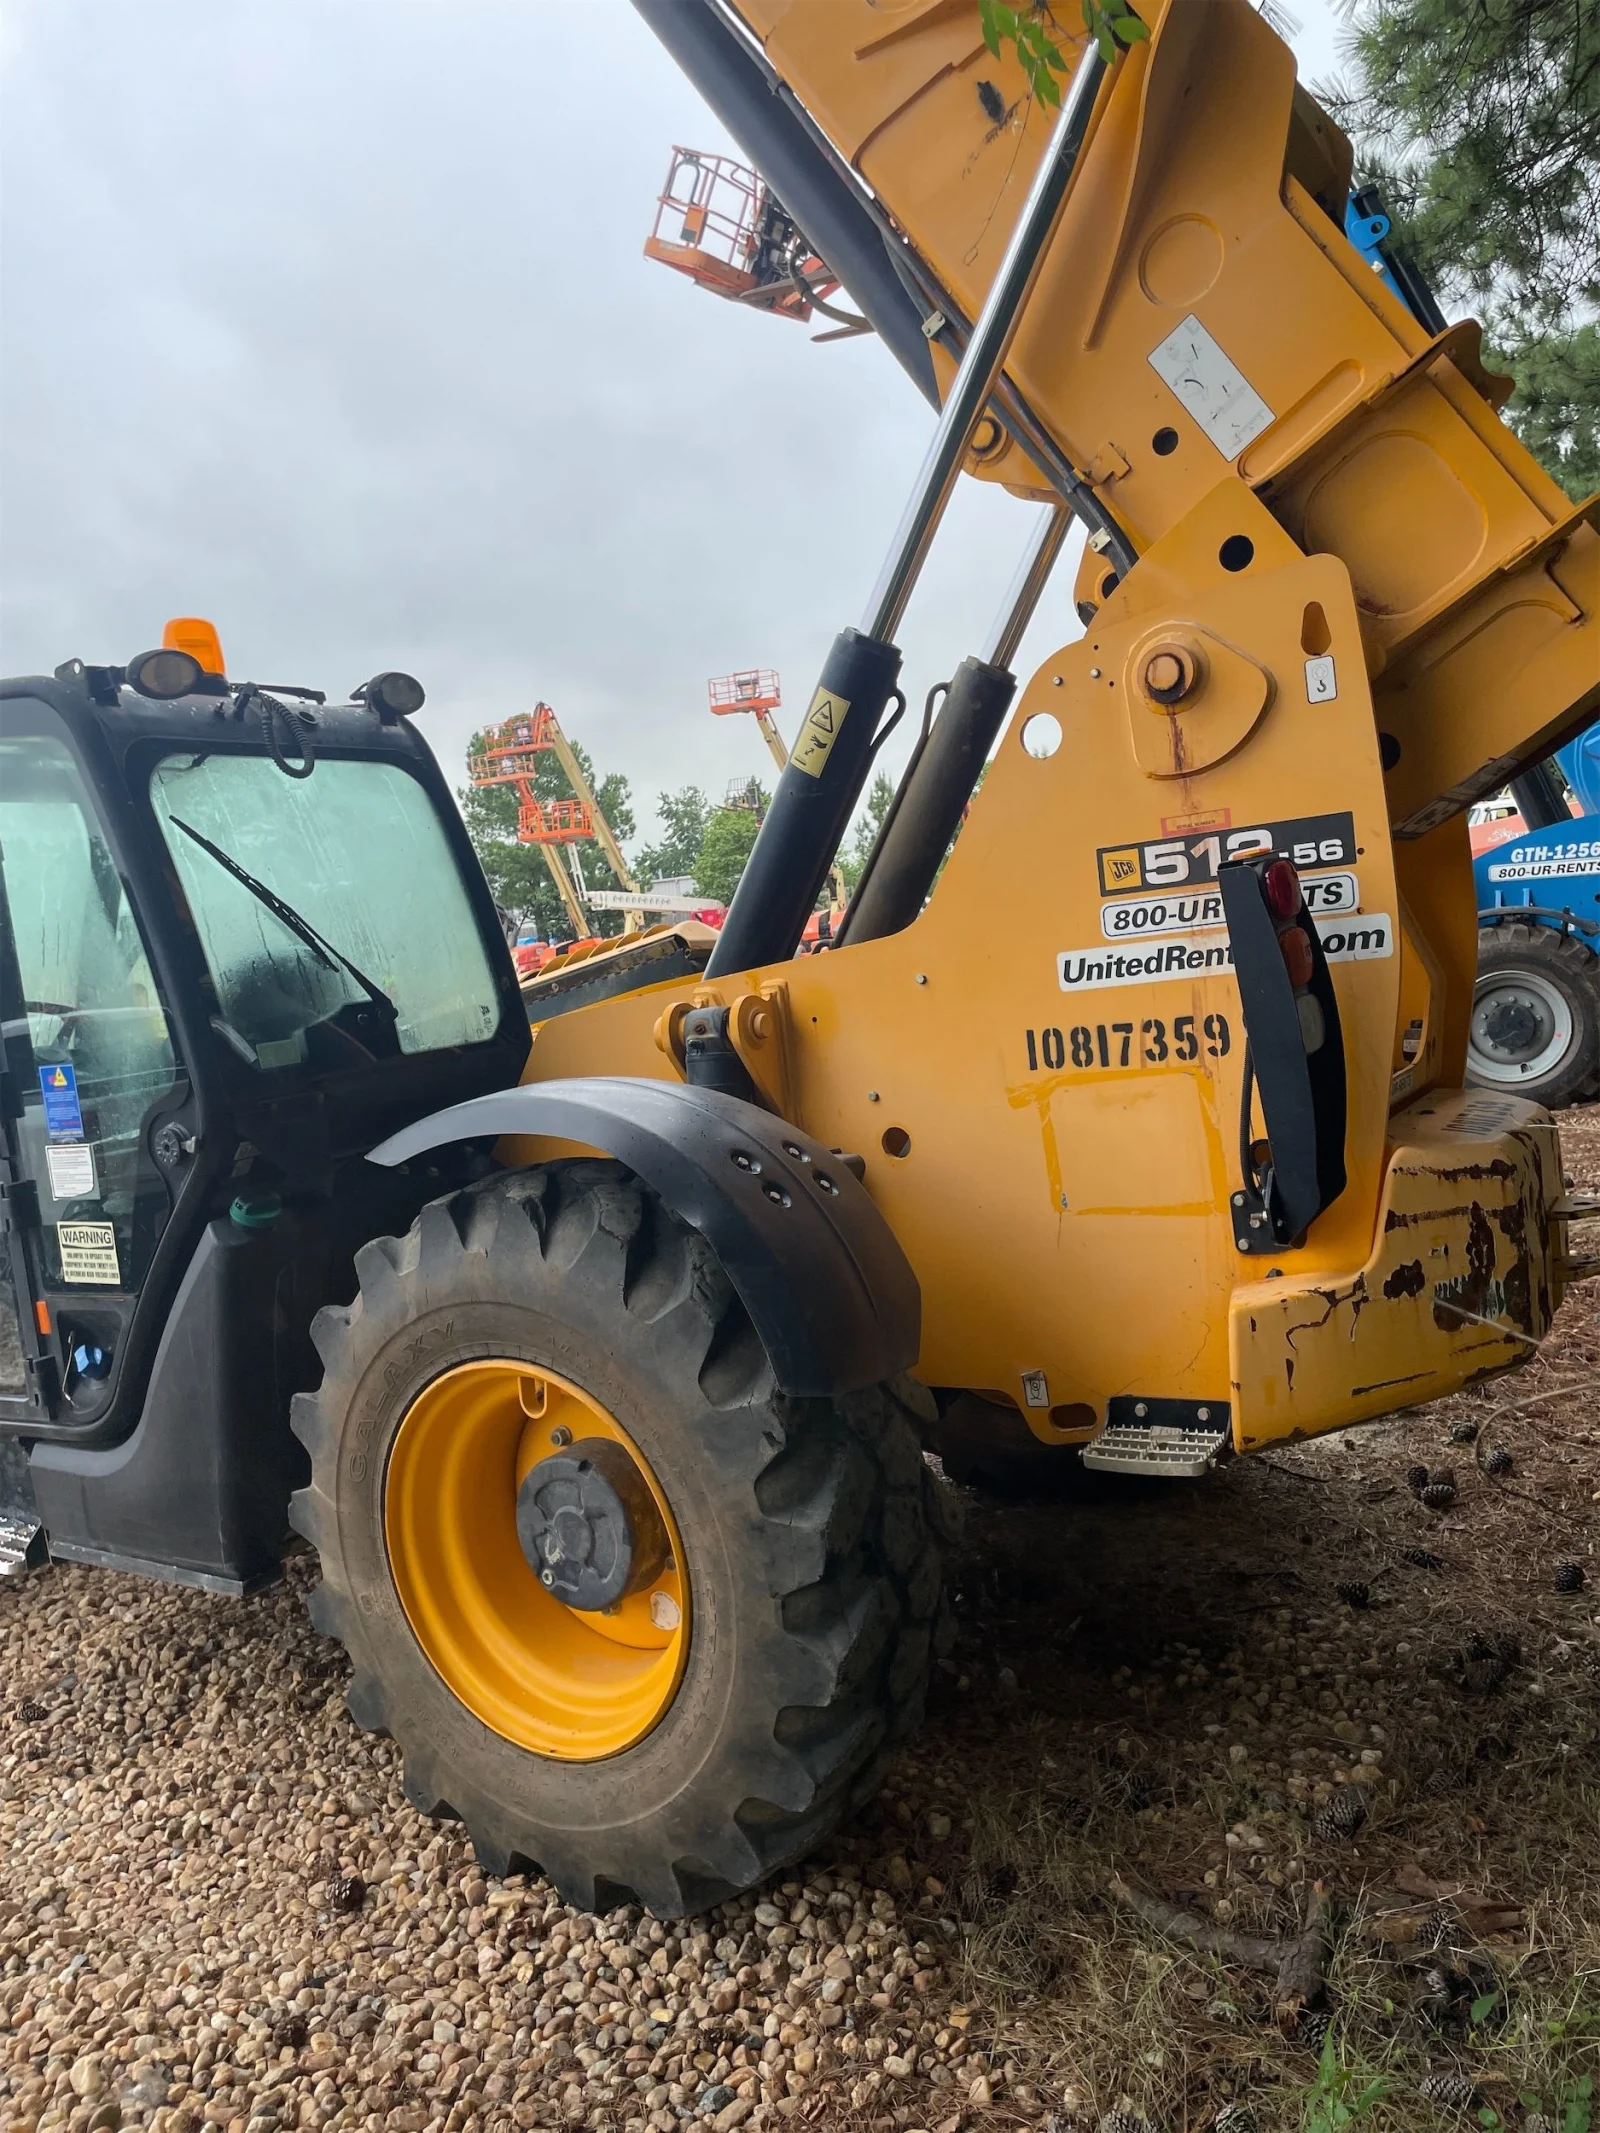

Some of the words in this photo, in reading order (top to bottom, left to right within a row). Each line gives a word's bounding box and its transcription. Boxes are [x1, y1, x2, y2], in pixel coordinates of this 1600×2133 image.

[1510, 841, 1600, 863] GTH-1256
[1112, 861, 1135, 880] JCB
[1026, 1013, 1231, 1071] 10817359
[62, 1230, 112, 1244] WARNING
[350, 1319, 454, 1483] GALAXY
